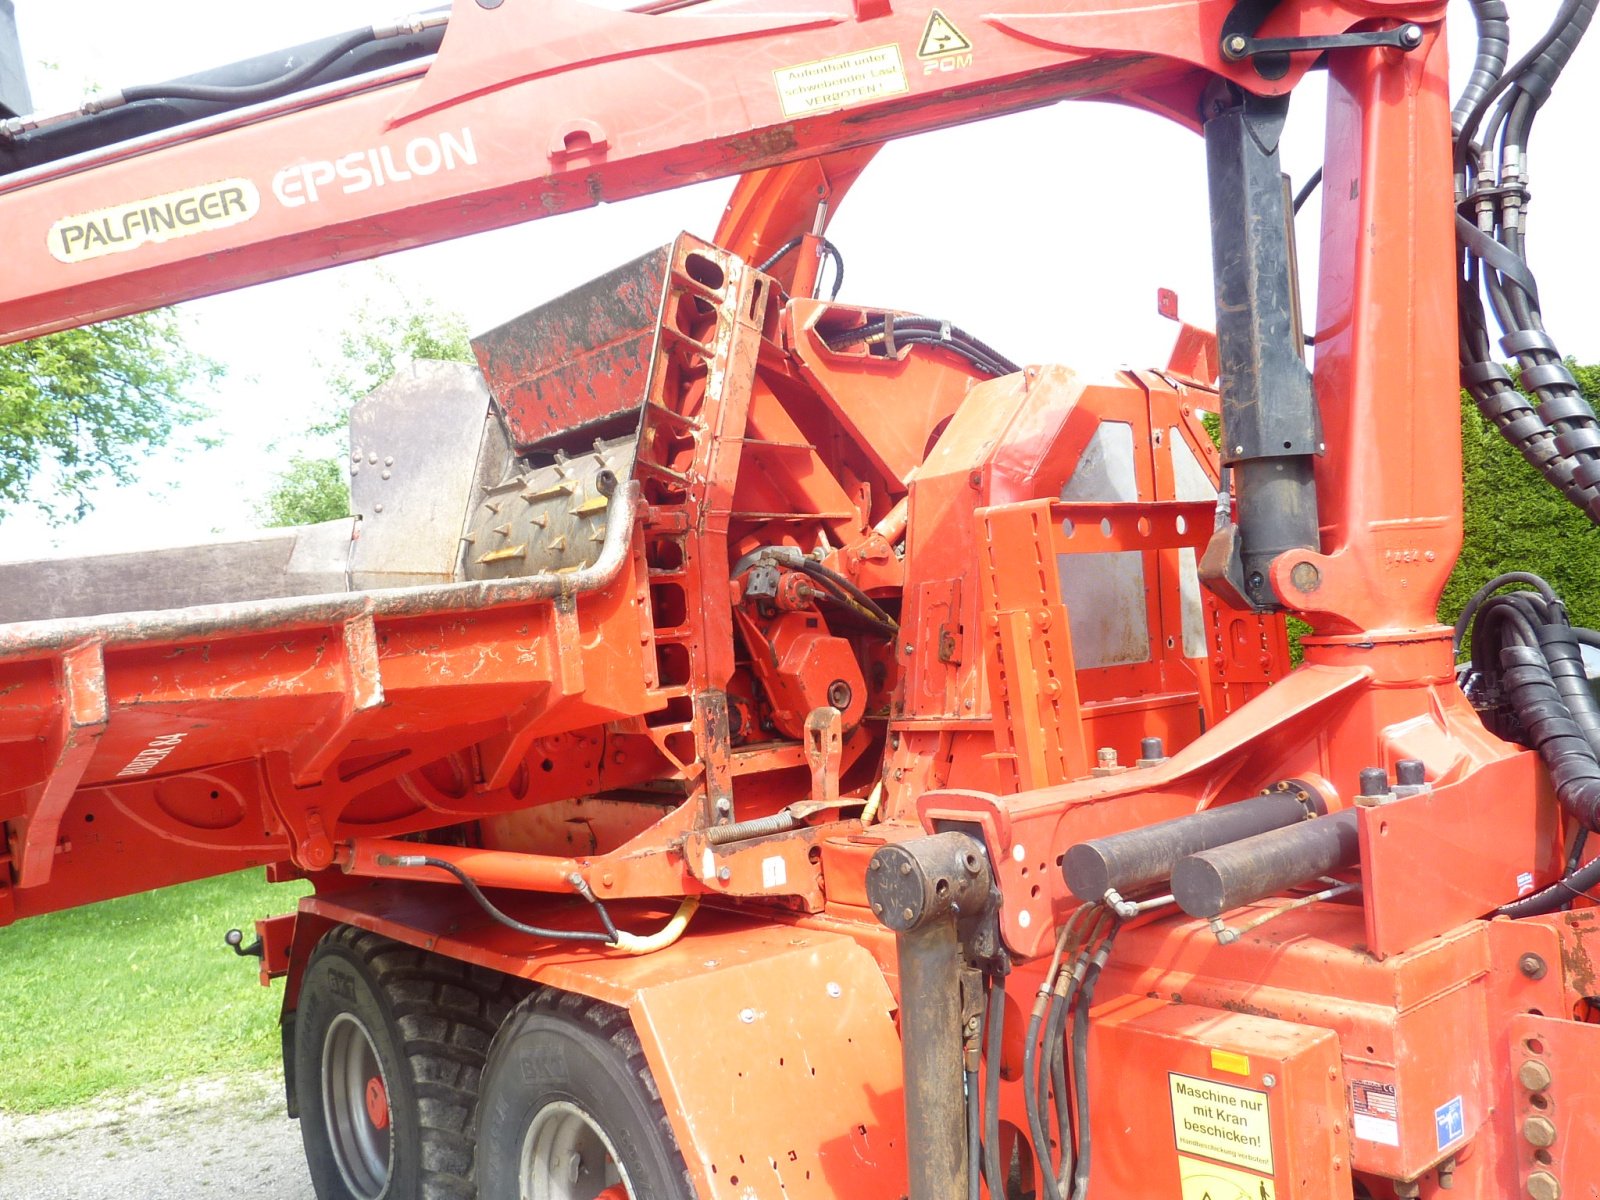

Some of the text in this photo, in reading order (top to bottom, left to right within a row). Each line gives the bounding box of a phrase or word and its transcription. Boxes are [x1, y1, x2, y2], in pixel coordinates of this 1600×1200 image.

[785, 65, 897, 96] schwebender Last
[788, 53, 888, 82] Aufenthalt unter
[60, 126, 478, 254] PALFINGER EPSILON
[116, 732, 188, 777] BIBER 84
[1176, 1082, 1263, 1112] Maschine nur
[1193, 1105, 1248, 1127] mit Kran
[1183, 1118, 1261, 1148] beschicken!
